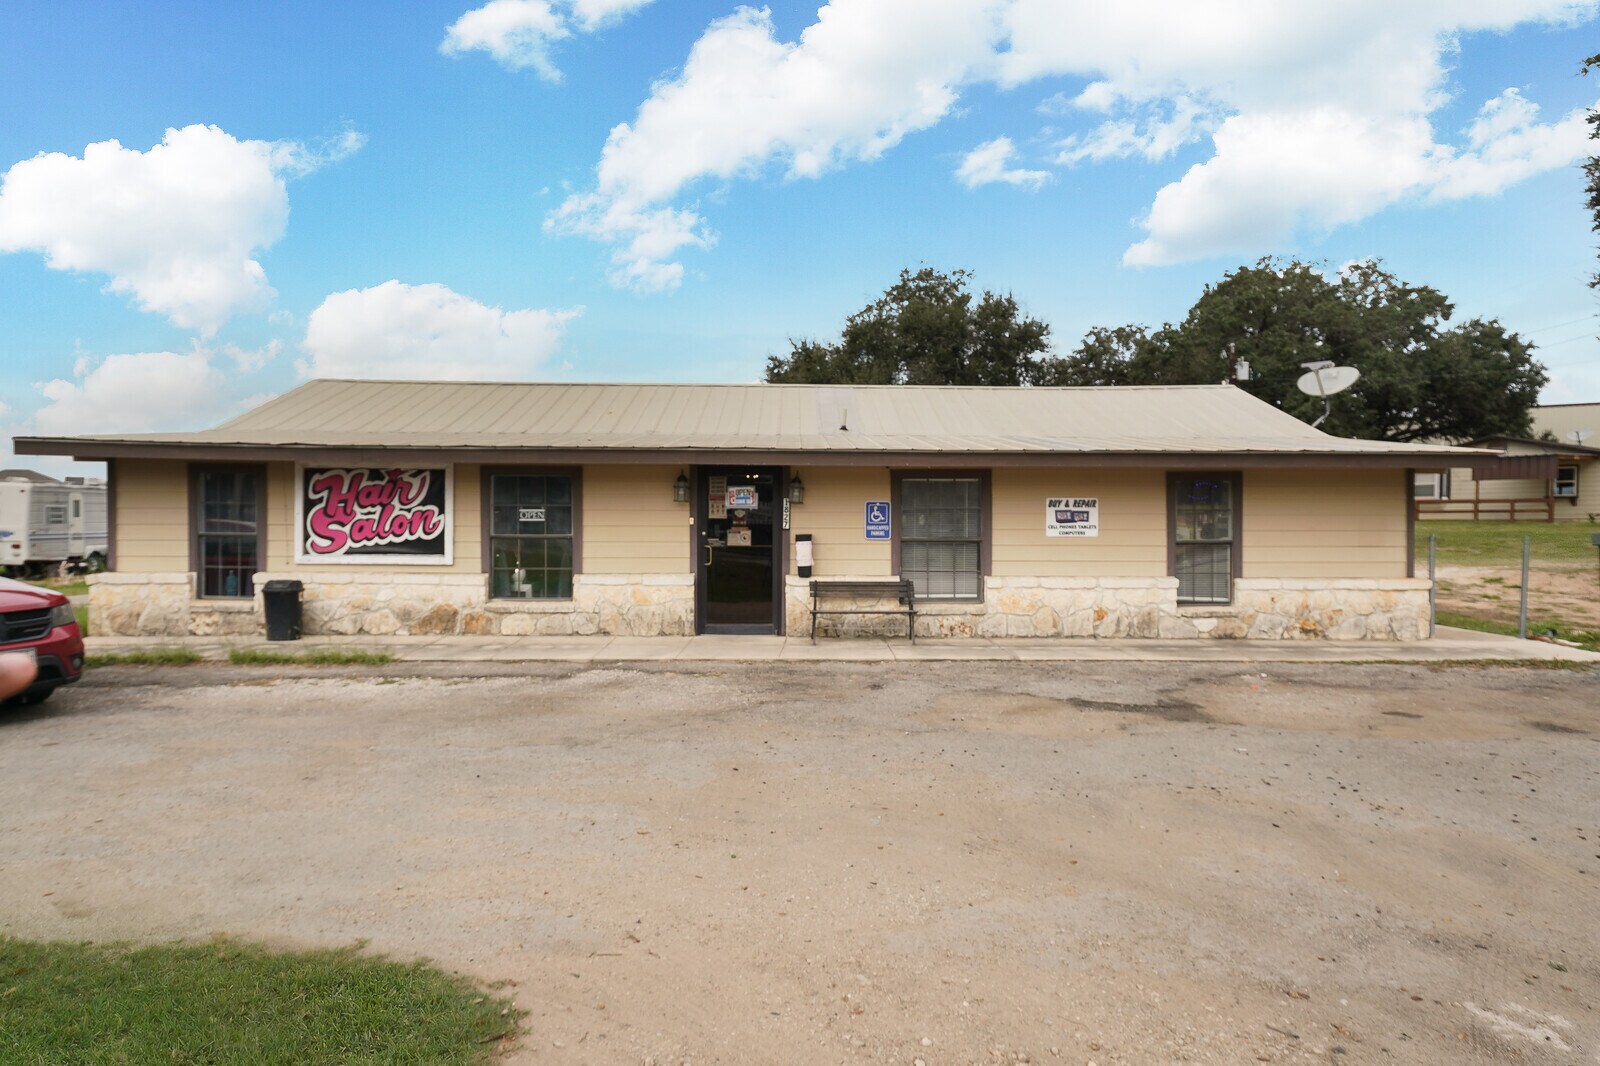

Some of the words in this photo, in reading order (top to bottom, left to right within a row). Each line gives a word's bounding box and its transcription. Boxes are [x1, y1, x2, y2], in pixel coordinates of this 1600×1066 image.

[311, 468, 426, 517] Hair
[1048, 499, 1063, 508] BUY
[1064, 499, 1070, 508] &
[1072, 499, 1097, 508] REPAIR
[310, 504, 440, 554] Salon
[519, 511, 545, 519] OPEN
